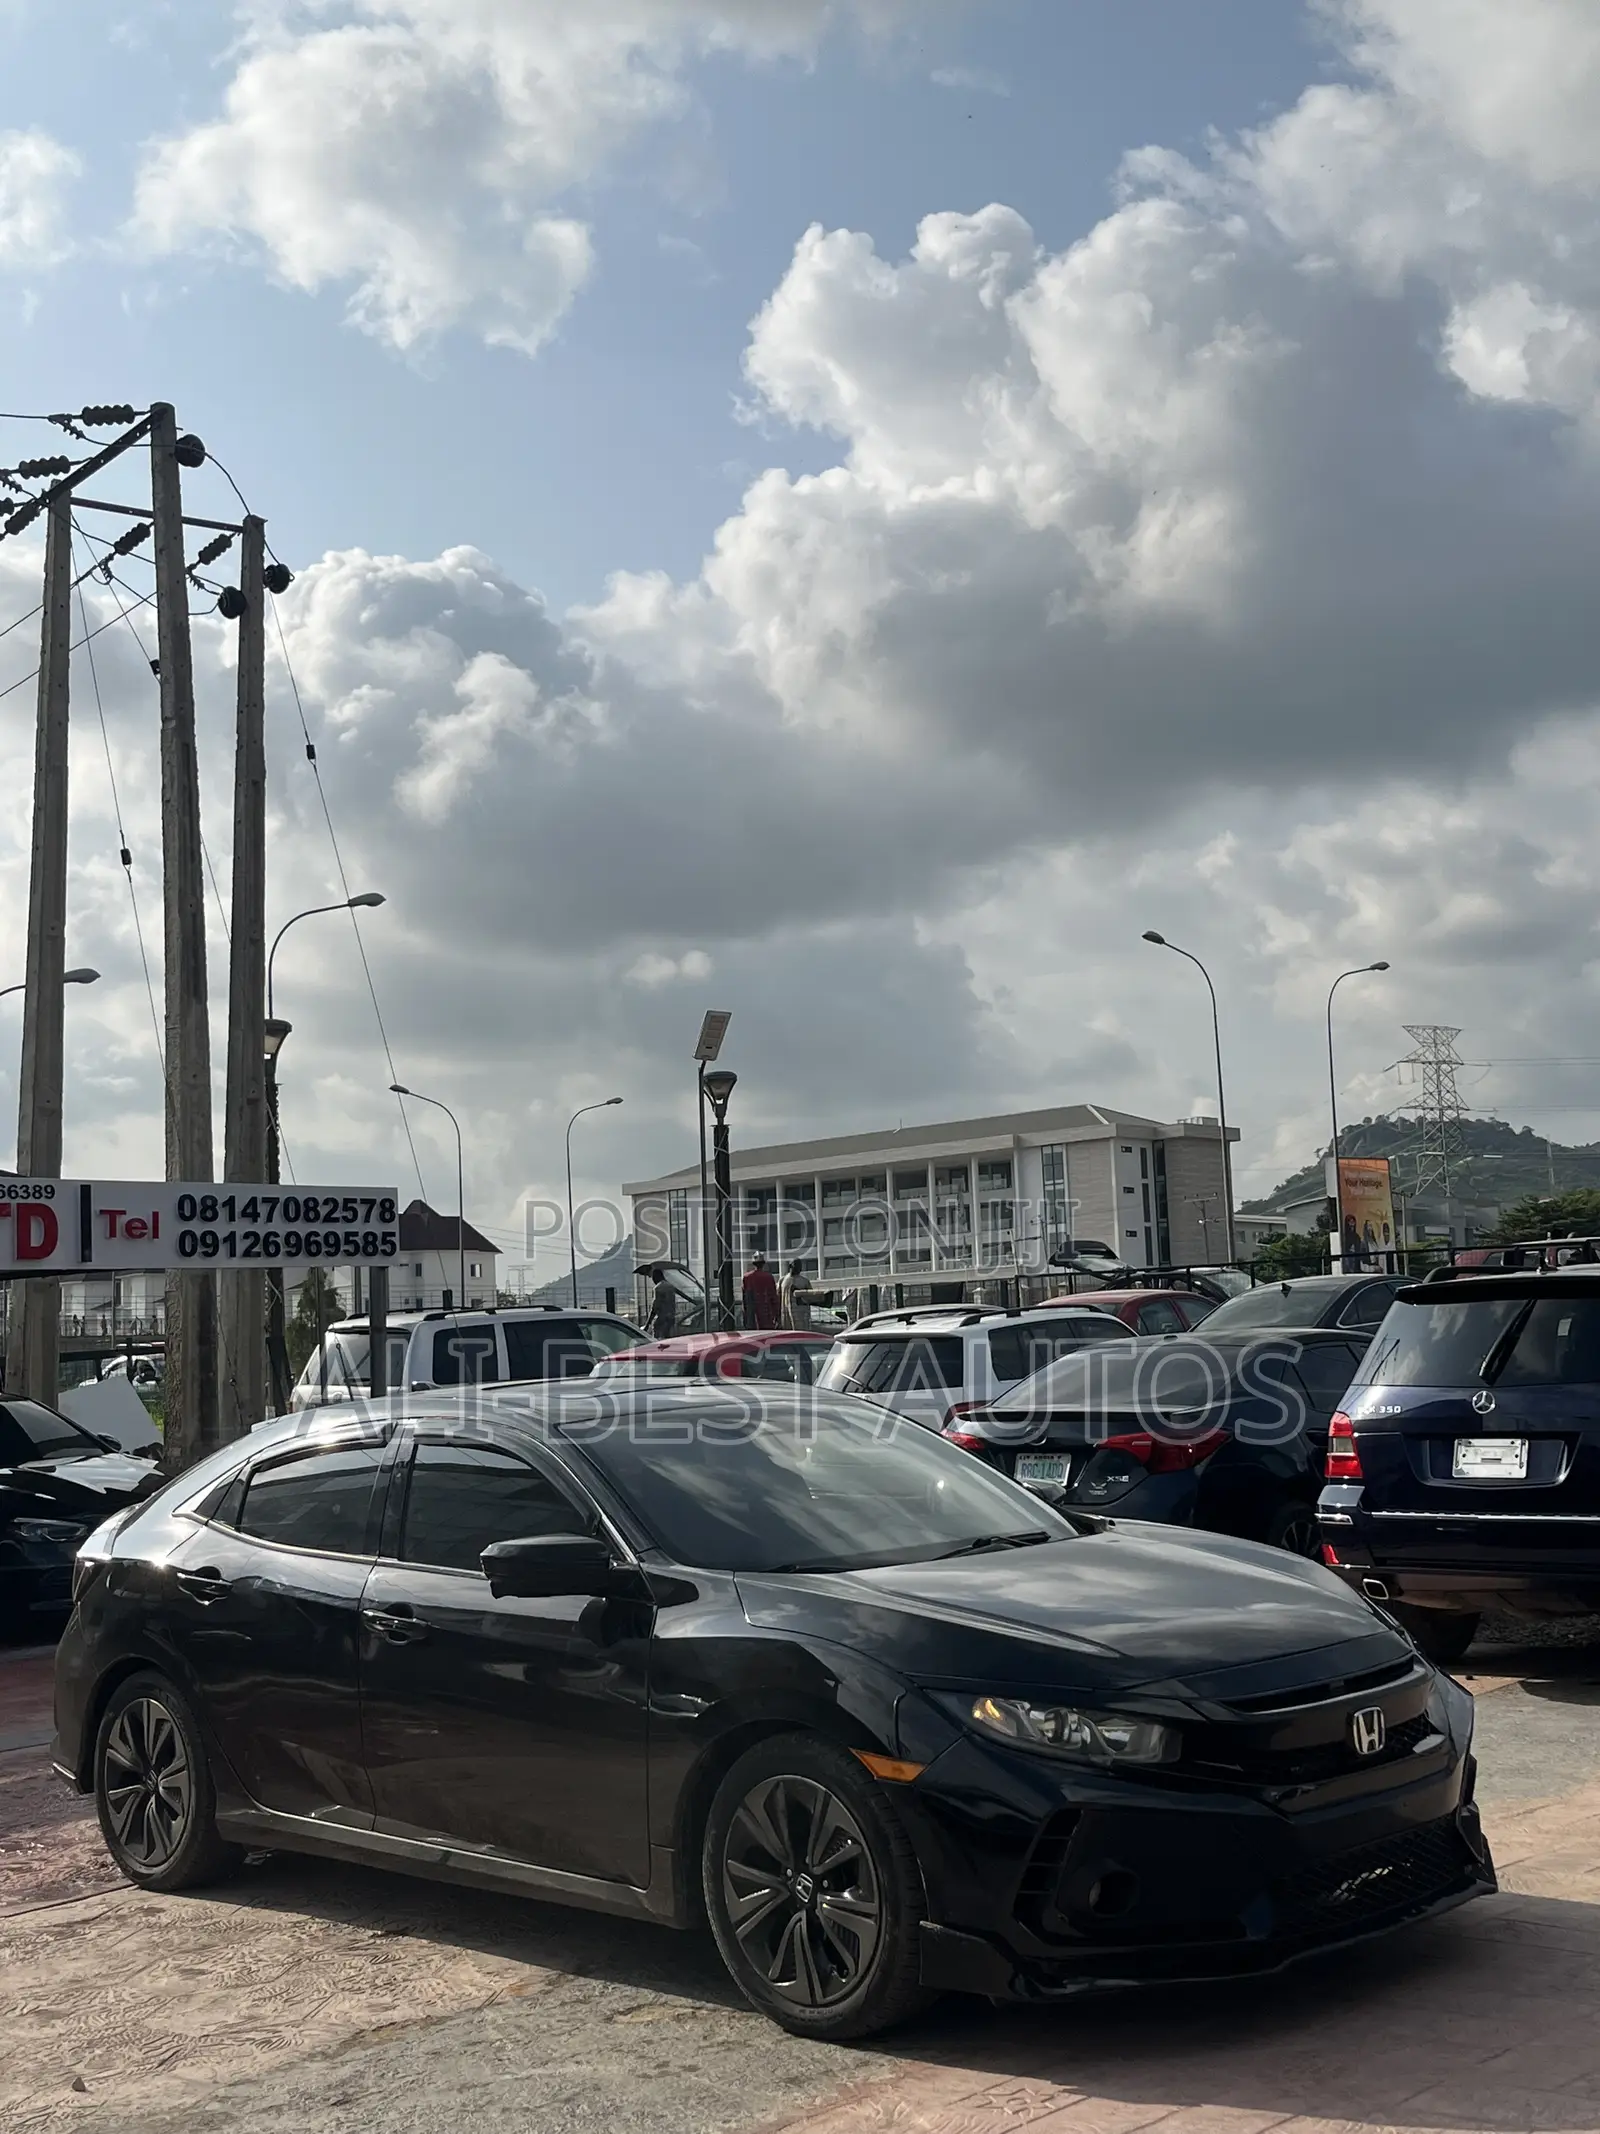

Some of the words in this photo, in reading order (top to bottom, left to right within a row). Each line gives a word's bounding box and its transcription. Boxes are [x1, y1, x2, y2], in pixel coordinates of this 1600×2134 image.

[100, 1209, 159, 1239] Tel
[177, 1194, 396, 1224] 08147082578
[178, 1230, 397, 1258] 09126969585
